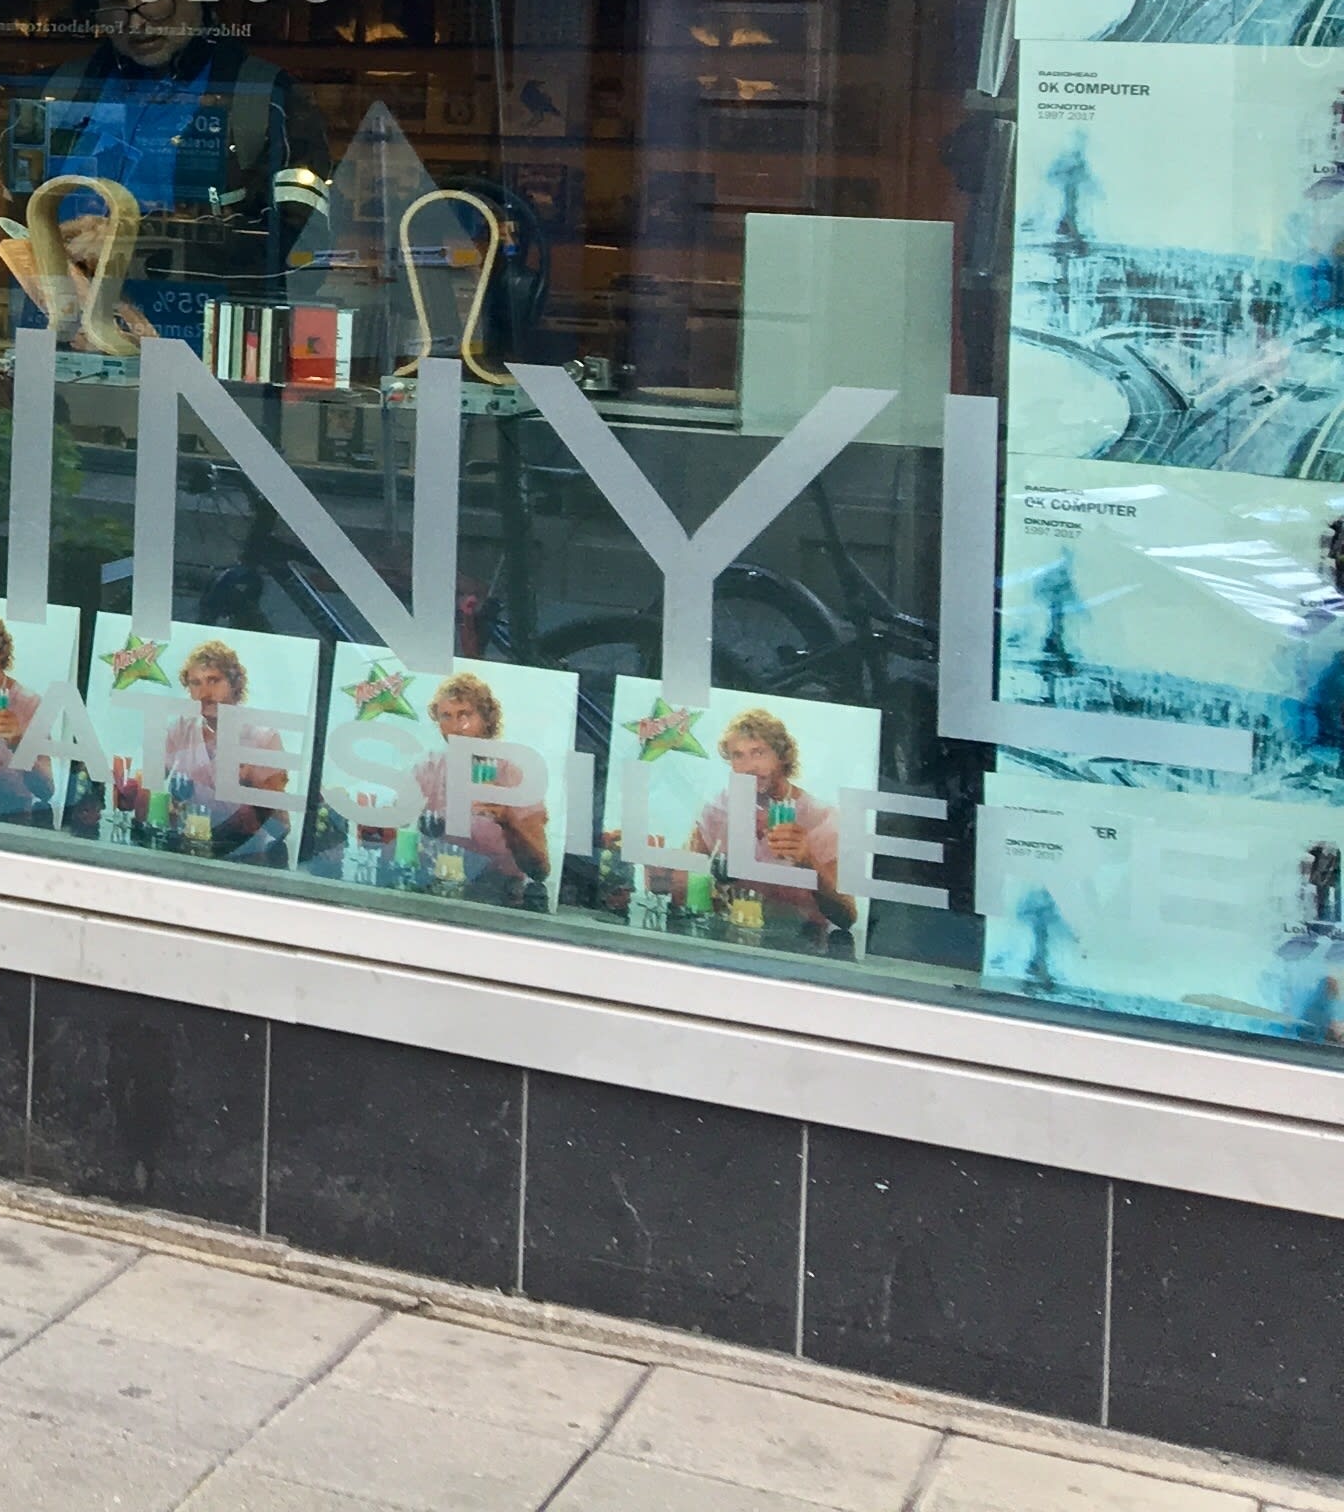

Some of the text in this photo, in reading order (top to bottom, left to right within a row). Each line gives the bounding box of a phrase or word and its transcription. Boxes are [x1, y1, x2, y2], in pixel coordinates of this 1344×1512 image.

[1038, 70, 1098, 78] RADIOHEAD
[1038, 81, 1150, 96] OK COMPUTER
[1037, 102, 1096, 111] OKNOTOK
[1037, 110, 1095, 121] 1997 2017
[1024, 496, 1137, 518] OK COMPUTER
[1024, 517, 1083, 529] OKNOTOK
[1054, 528, 1082, 539] 2017
